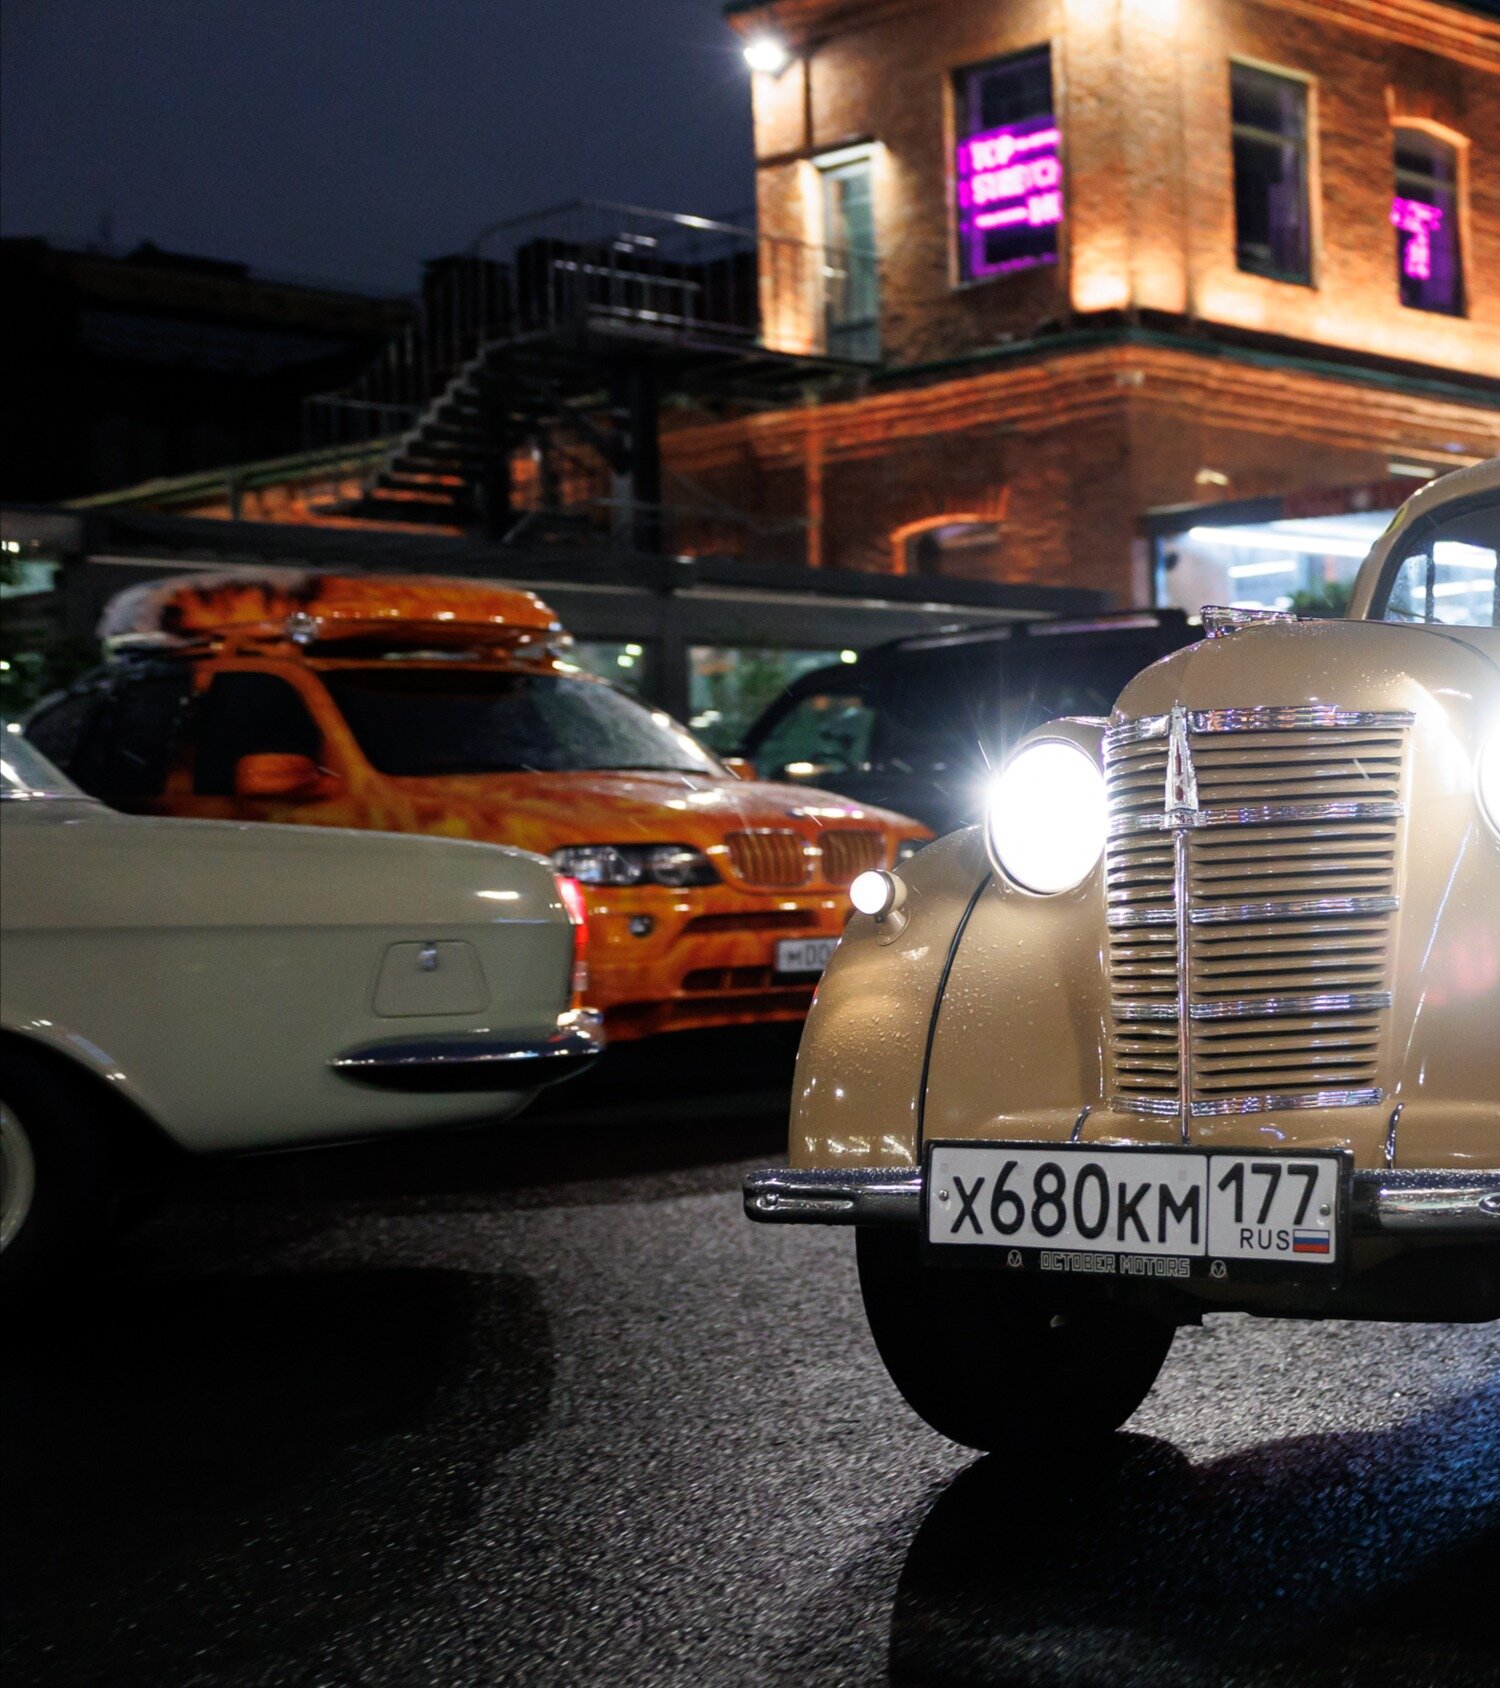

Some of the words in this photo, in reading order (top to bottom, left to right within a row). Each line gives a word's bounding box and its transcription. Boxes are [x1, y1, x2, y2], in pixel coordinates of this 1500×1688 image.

[1217, 1161, 1319, 1226] 177
[1240, 1227, 1290, 1251] RUS
[1040, 1250, 1116, 1274] OCTOBER
[1119, 1254, 1191, 1278] MOTORS
